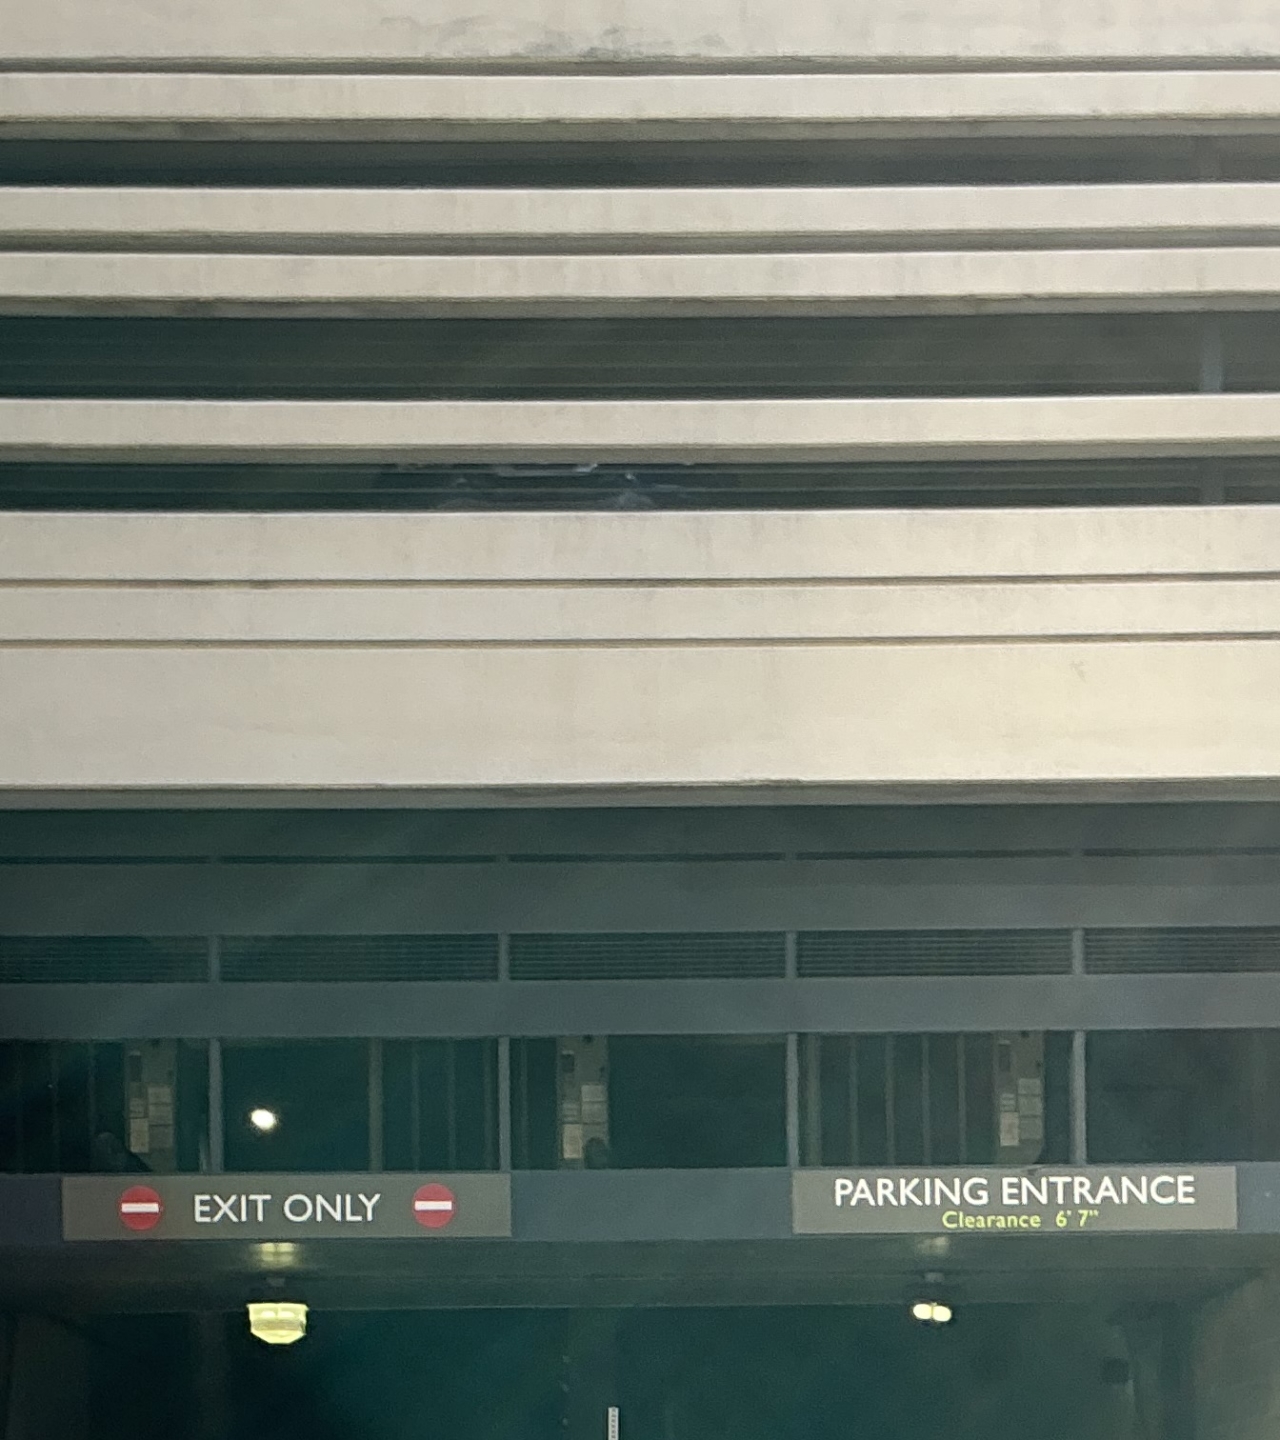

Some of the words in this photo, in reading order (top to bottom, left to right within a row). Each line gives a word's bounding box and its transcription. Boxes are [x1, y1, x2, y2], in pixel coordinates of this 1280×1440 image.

[834, 1177, 990, 1207] PARKING
[1001, 1175, 1196, 1206] ENTRANCE
[194, 1194, 271, 1223] EXIT
[283, 1193, 381, 1223] ONLY
[942, 1210, 1042, 1229] Clearance
